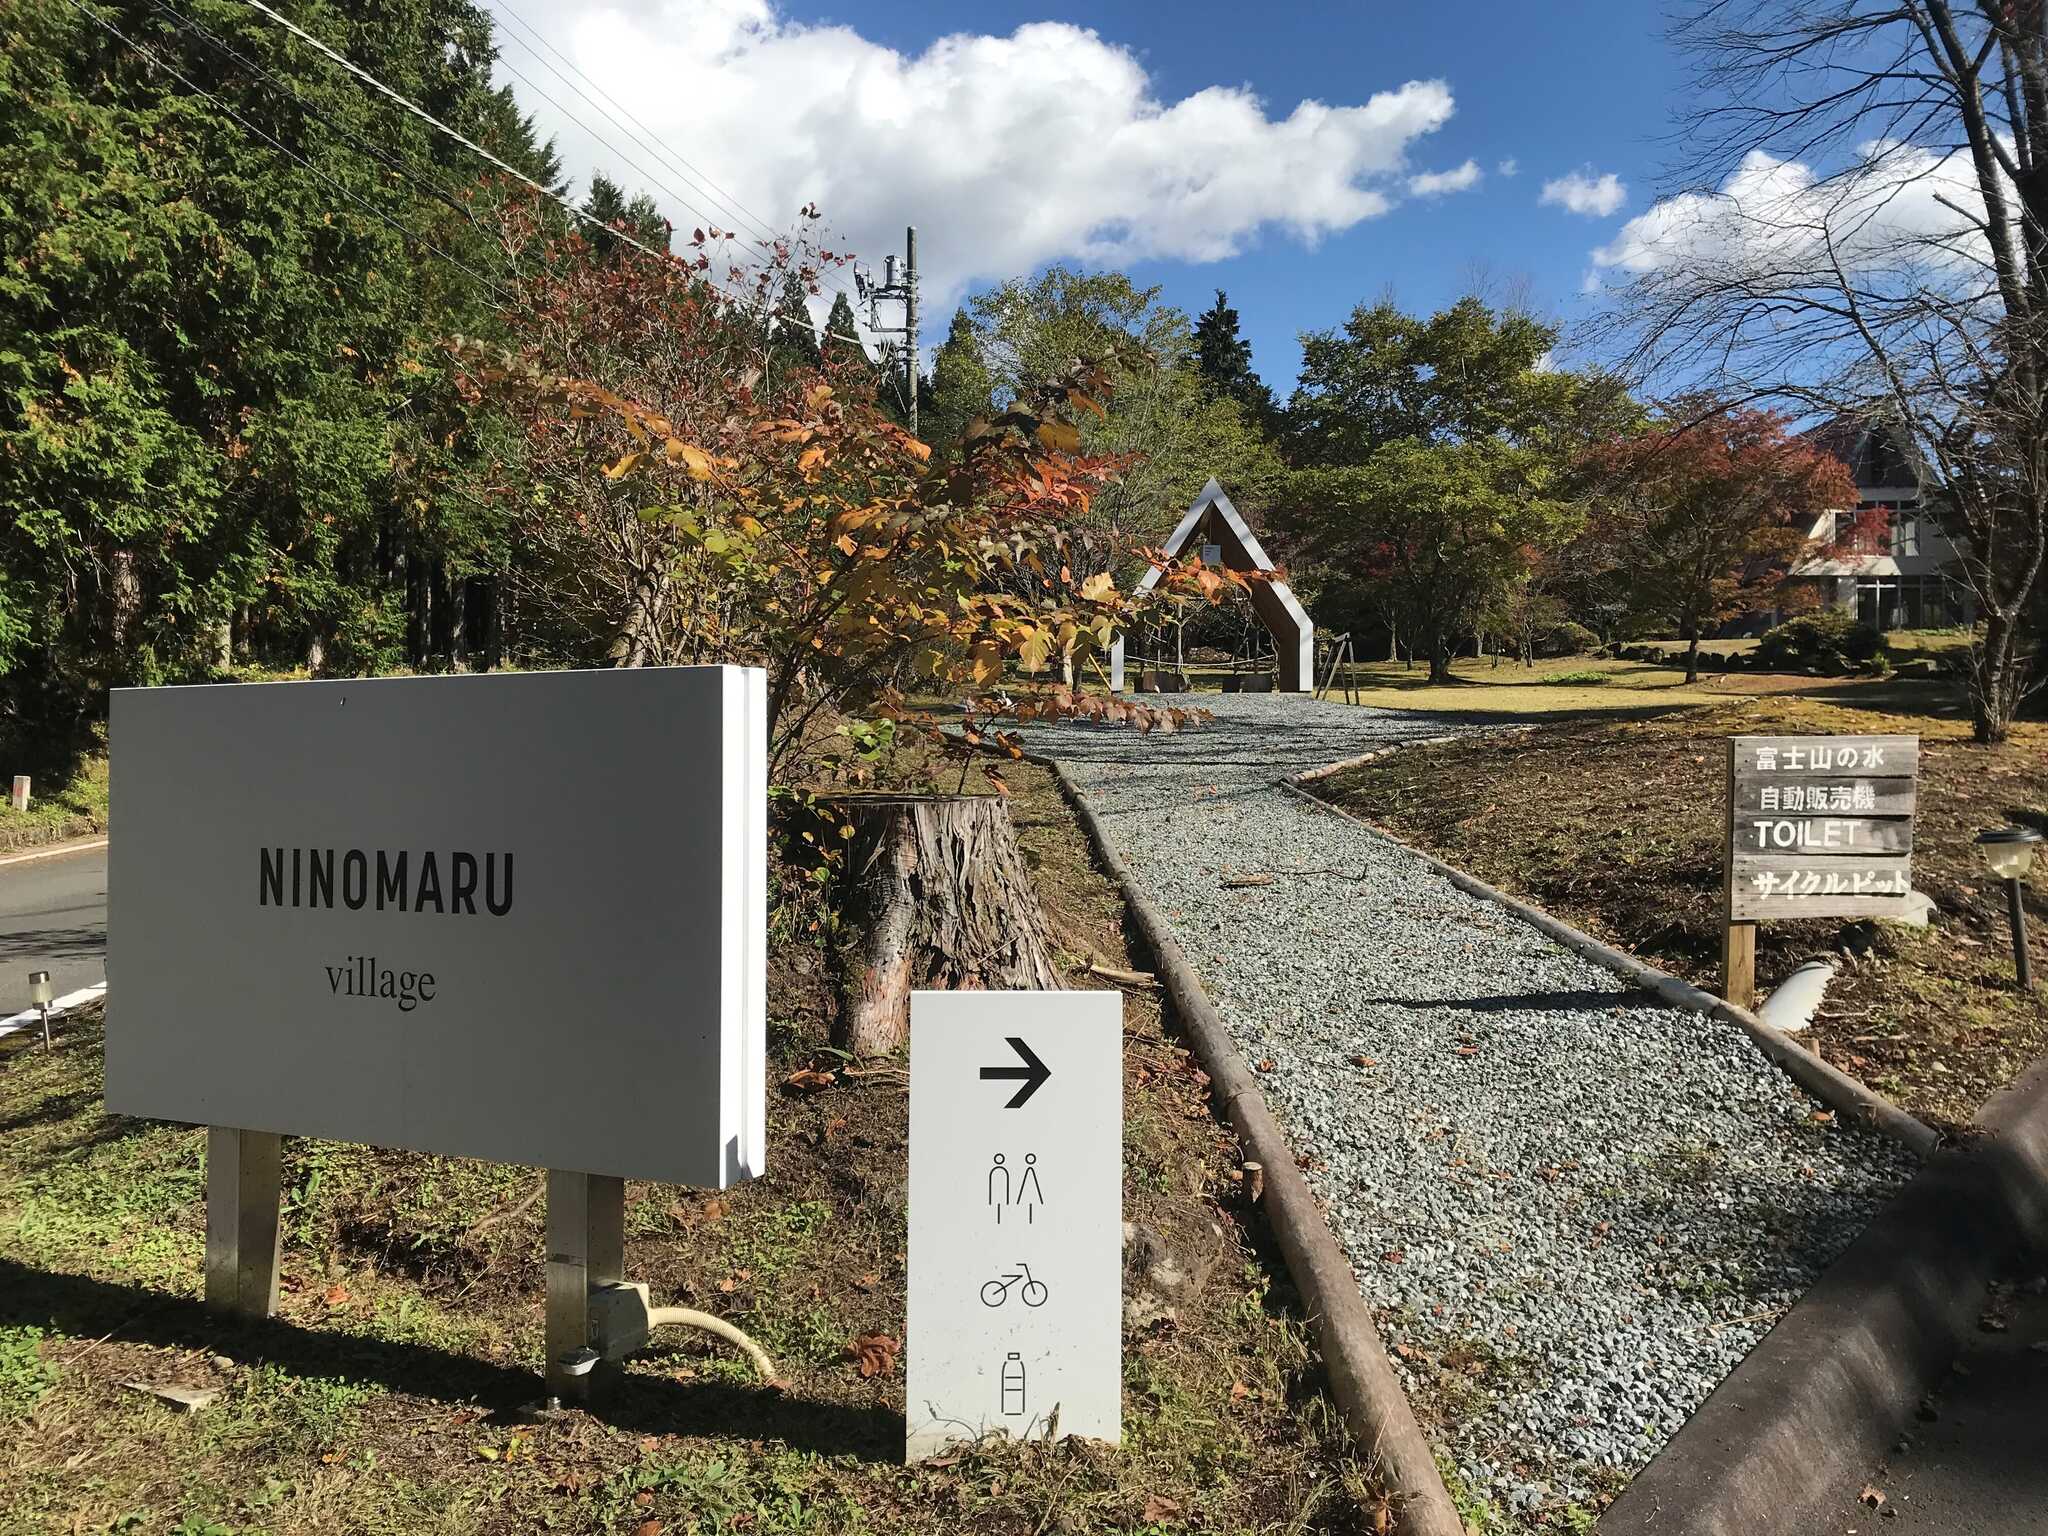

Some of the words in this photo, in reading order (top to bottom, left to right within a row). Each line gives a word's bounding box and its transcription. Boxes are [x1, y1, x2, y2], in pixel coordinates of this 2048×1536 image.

[1755, 745, 1885, 770] 富士山の水
[1760, 785, 1876, 811] 自動販売機
[1753, 820, 1862, 848] TOILET
[258, 847, 514, 917] NINOMARU
[1752, 870, 1911, 900] サイクルピット
[324, 955, 438, 1013] village
